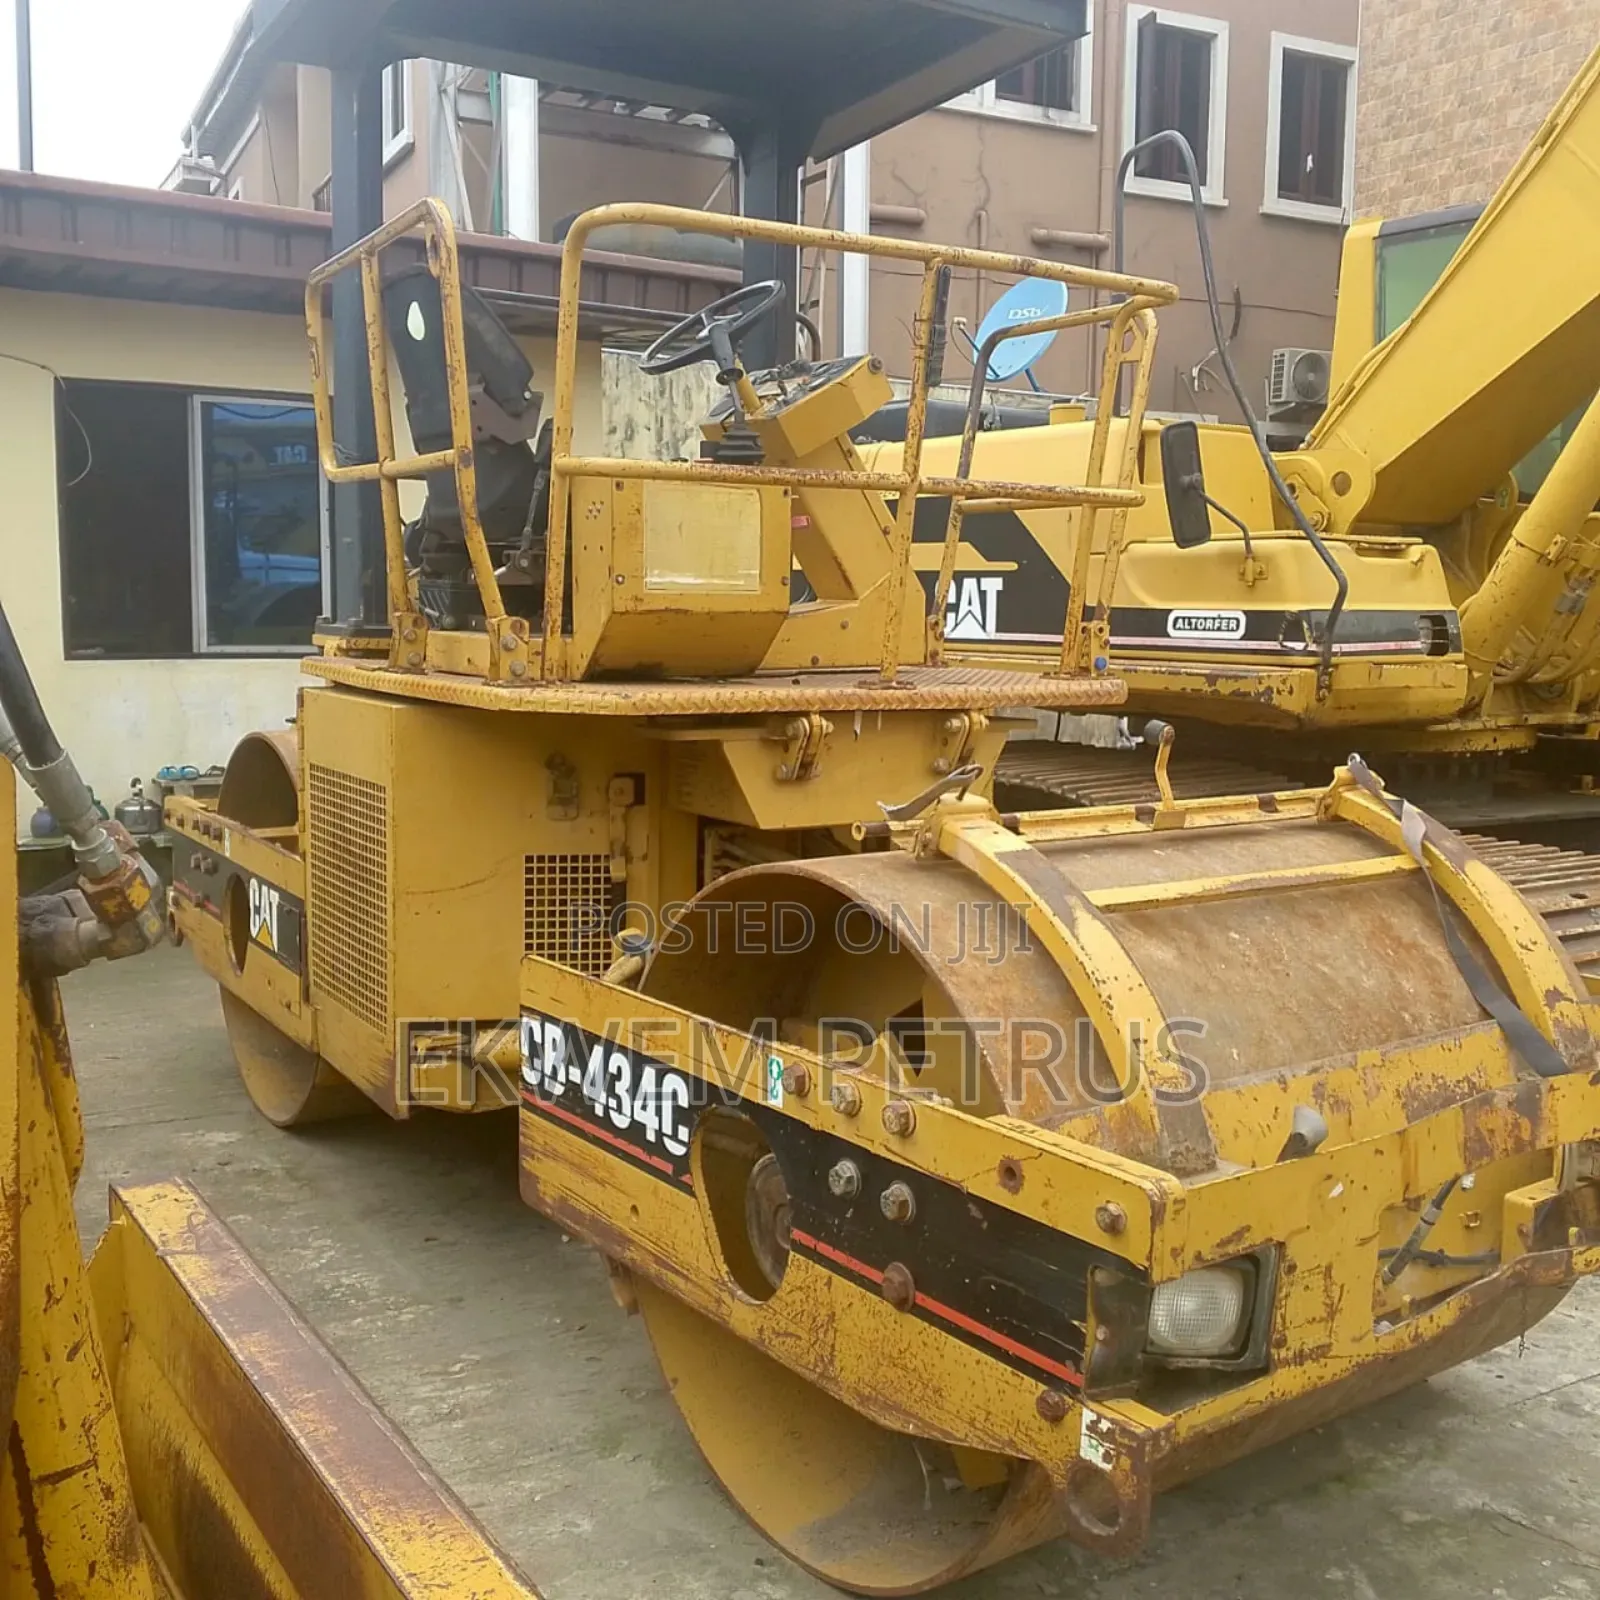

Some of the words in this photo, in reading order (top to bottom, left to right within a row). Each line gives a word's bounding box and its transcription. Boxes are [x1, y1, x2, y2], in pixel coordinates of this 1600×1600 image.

[1175, 617, 1238, 631] ALTORFER
[249, 878, 280, 953] CAT
[520, 1016, 690, 1157] CB-434C
